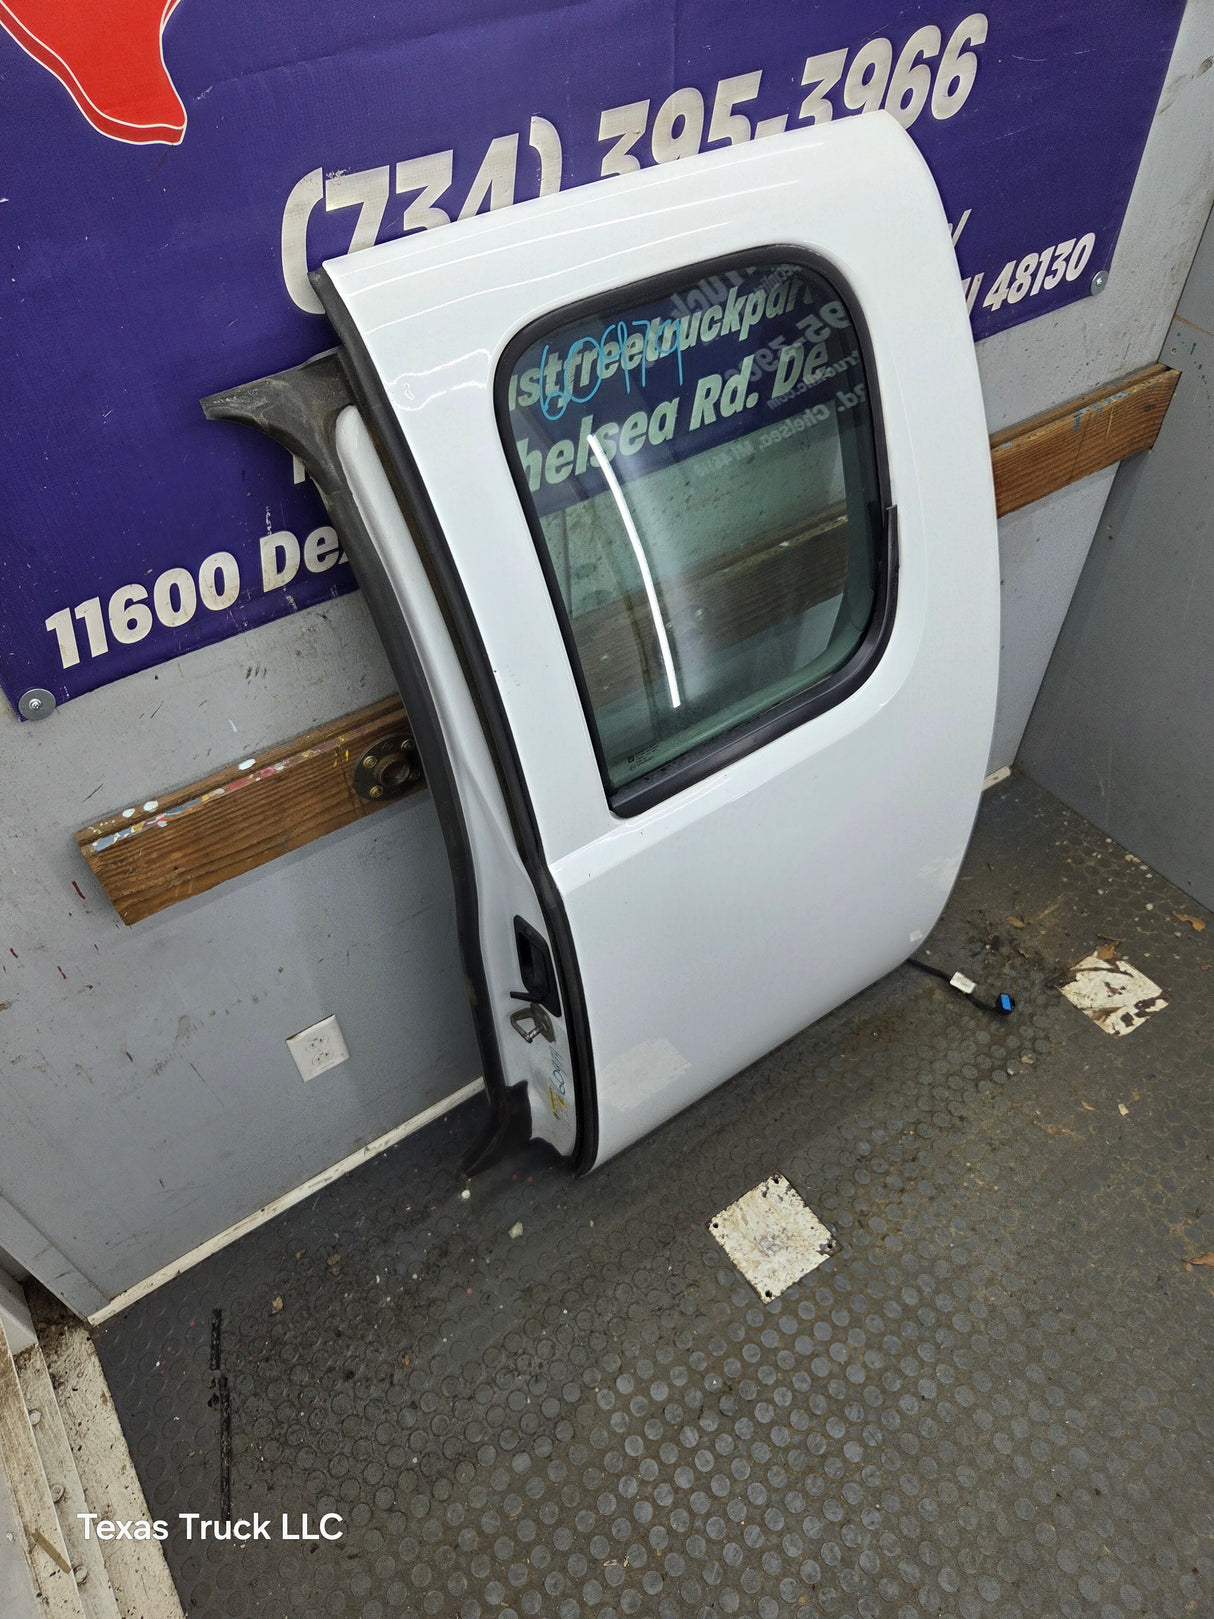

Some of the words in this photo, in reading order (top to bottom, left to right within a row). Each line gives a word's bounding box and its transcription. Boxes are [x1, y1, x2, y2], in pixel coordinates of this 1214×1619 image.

[281, 116, 563, 315] (734)
[598, 13, 989, 178] 395-3966
[982, 232, 1096, 312] 48130
[45, 551, 240, 669] 11600
[260, 525, 352, 593] De
[689, 353, 759, 431] Rd.
